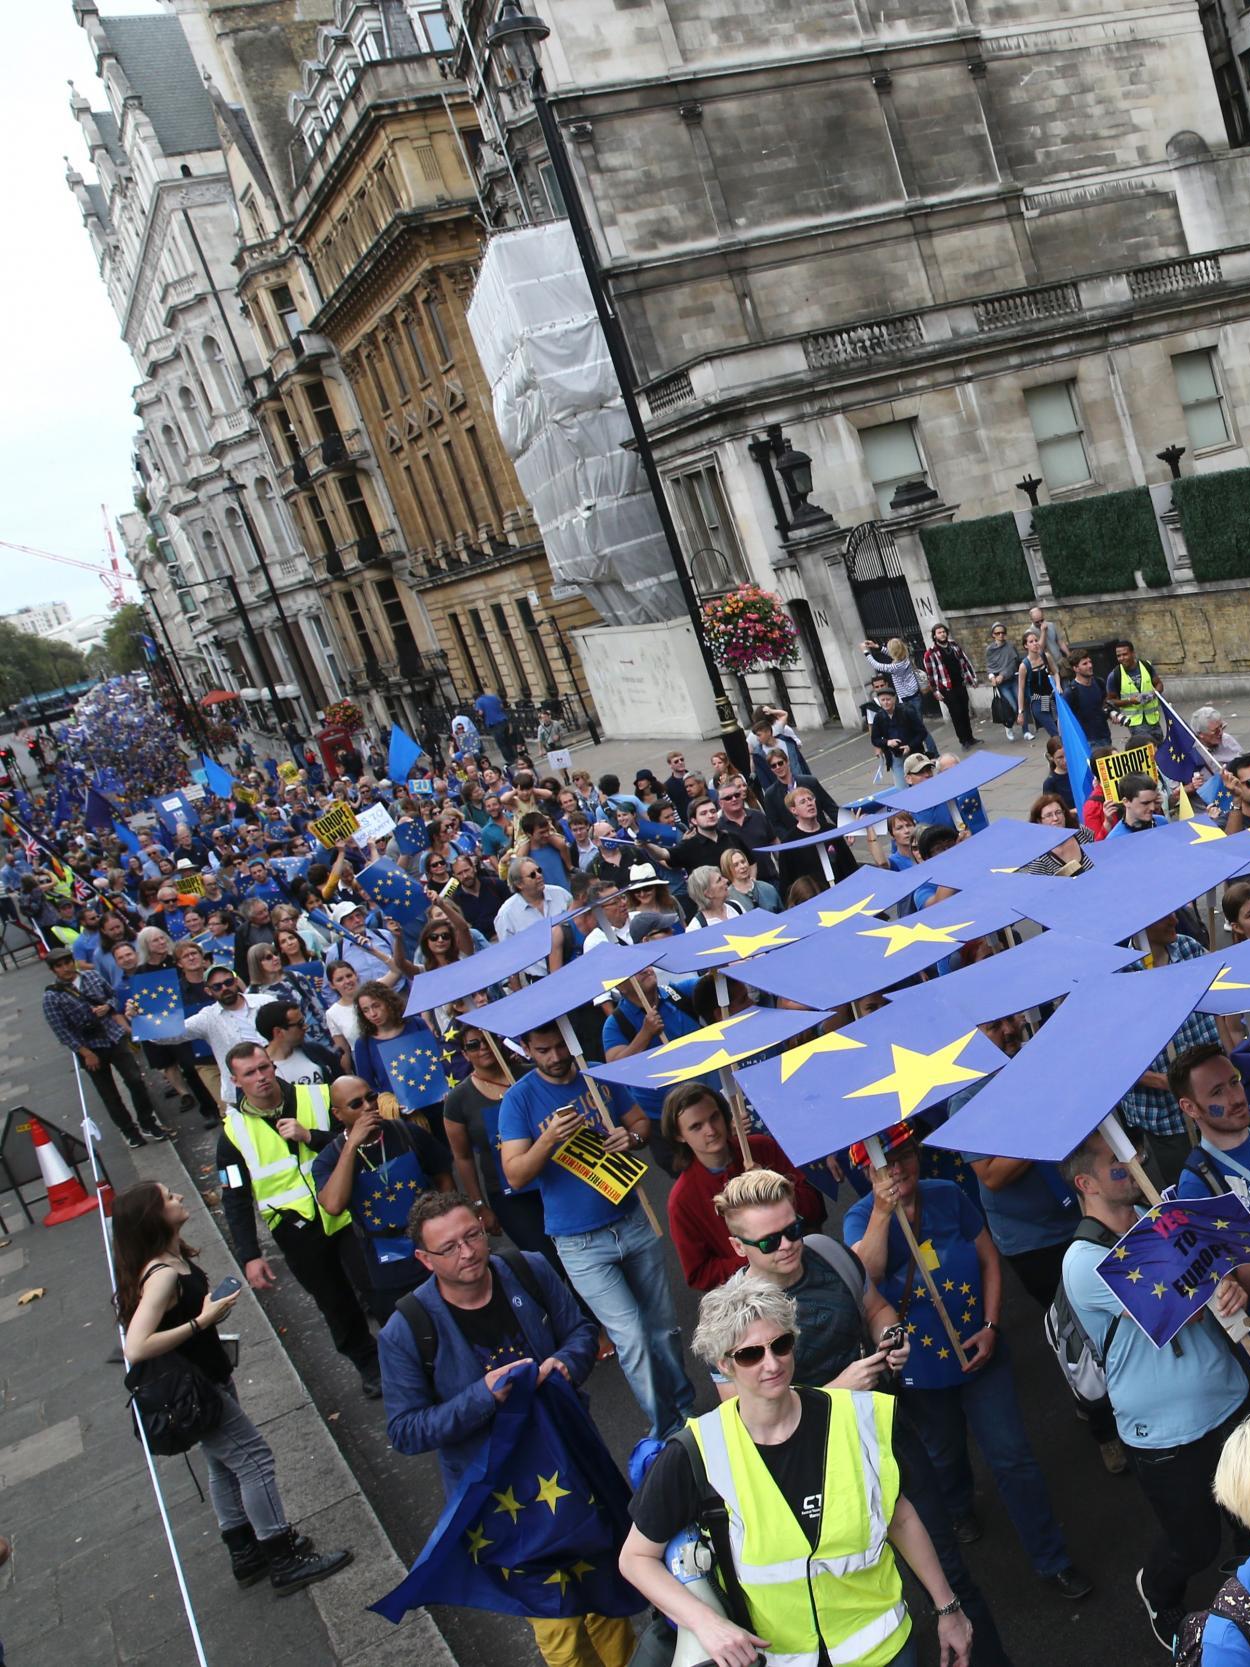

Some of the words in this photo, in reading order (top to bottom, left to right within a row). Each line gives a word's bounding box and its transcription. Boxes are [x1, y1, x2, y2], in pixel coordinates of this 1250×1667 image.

[813, 609, 830, 629] IN
[914, 597, 934, 618] IN
[1105, 747, 1151, 781] EUROPE
[314, 806, 350, 837] EUROPE
[326, 820, 355, 846] INNIT!
[563, 1127, 608, 1170] EUR
[1152, 1207, 1191, 1239] YES
[1173, 1229, 1198, 1257] TO
[1172, 1241, 1232, 1297] EUROPE
